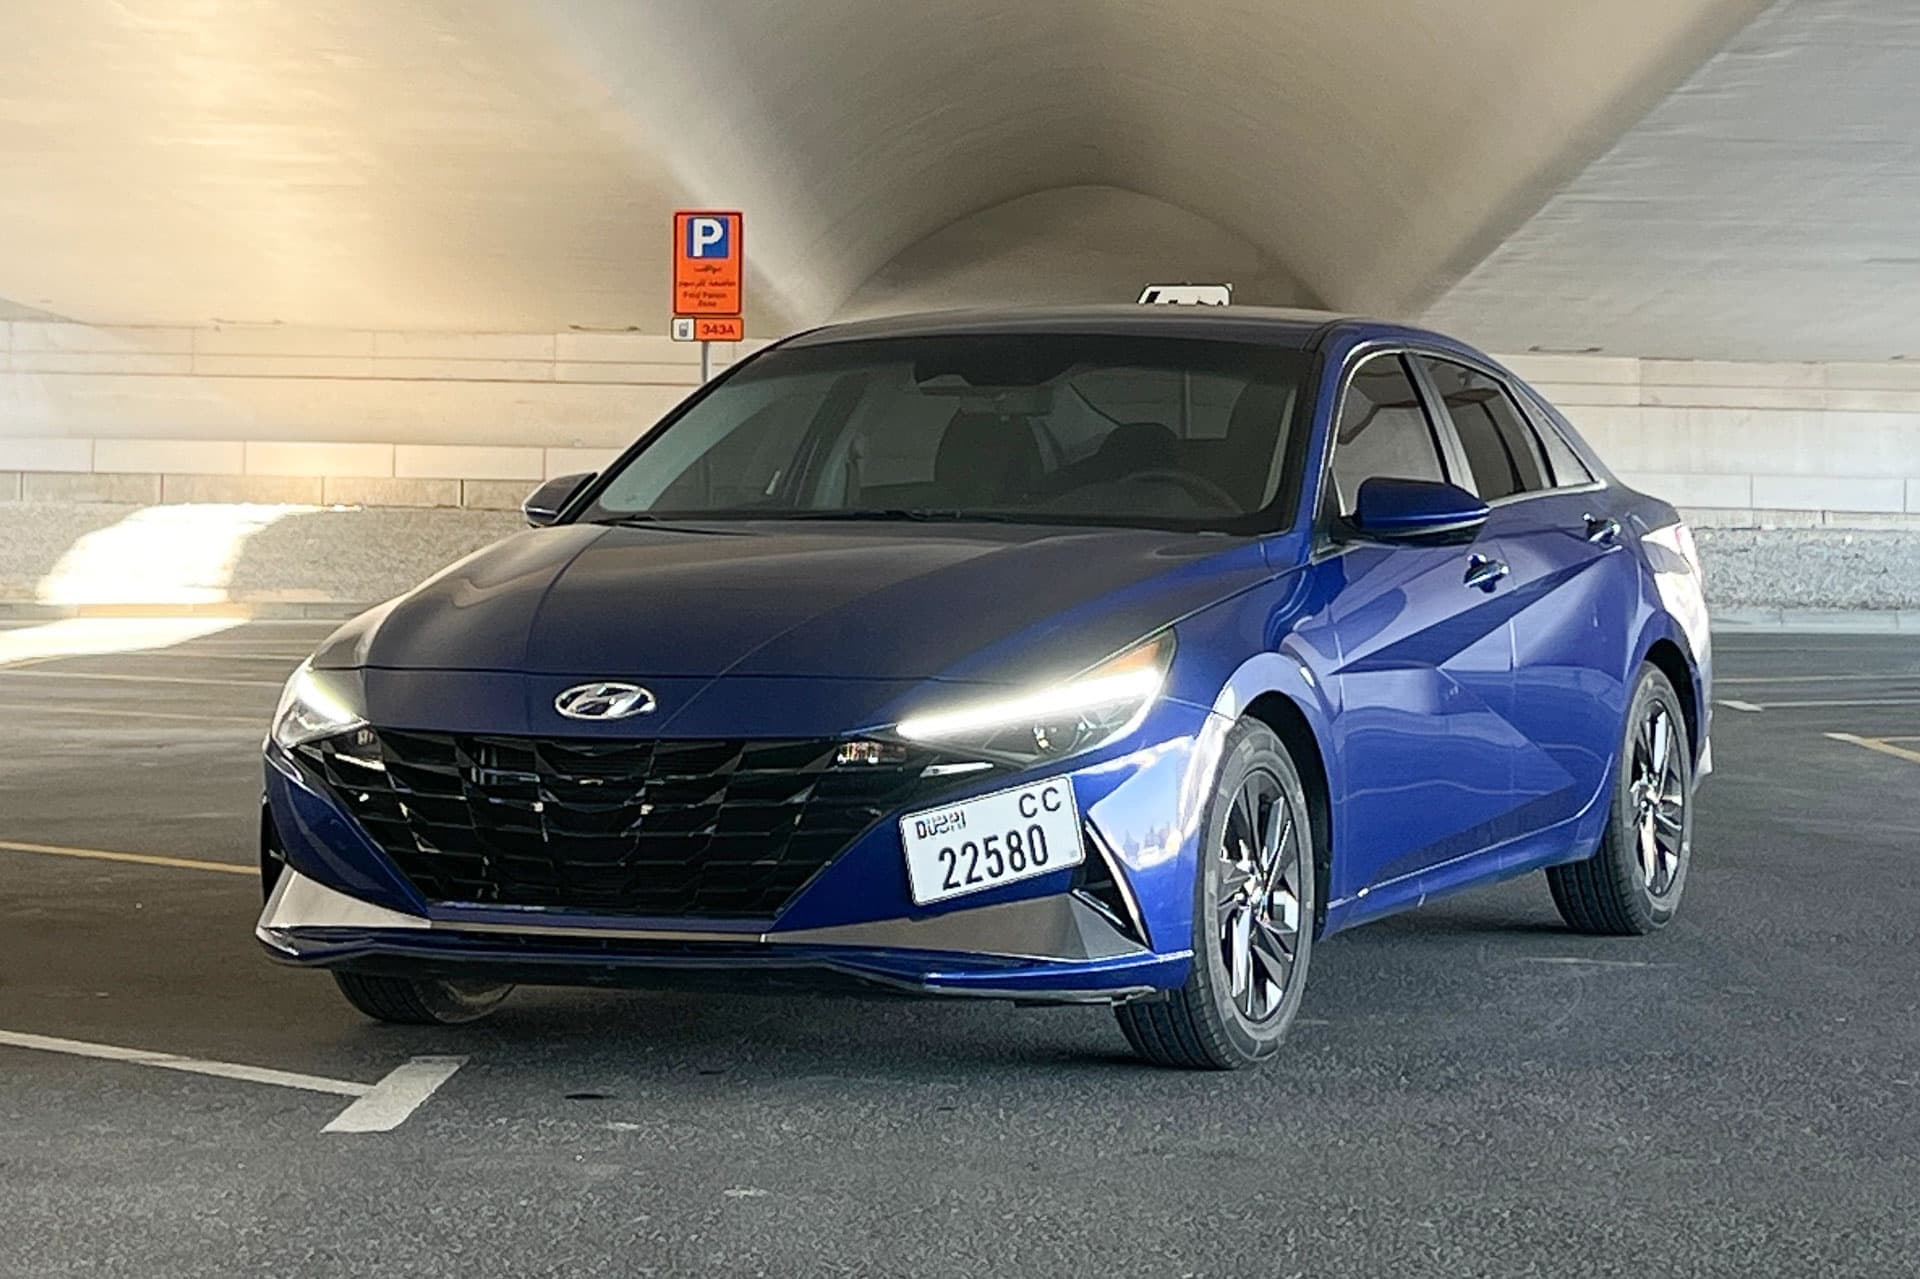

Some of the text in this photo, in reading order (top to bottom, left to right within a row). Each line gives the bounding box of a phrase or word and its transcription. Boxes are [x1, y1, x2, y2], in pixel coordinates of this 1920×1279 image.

[692, 218, 724, 257] P
[702, 324, 735, 335] 343A
[938, 824, 1049, 891] 22580
